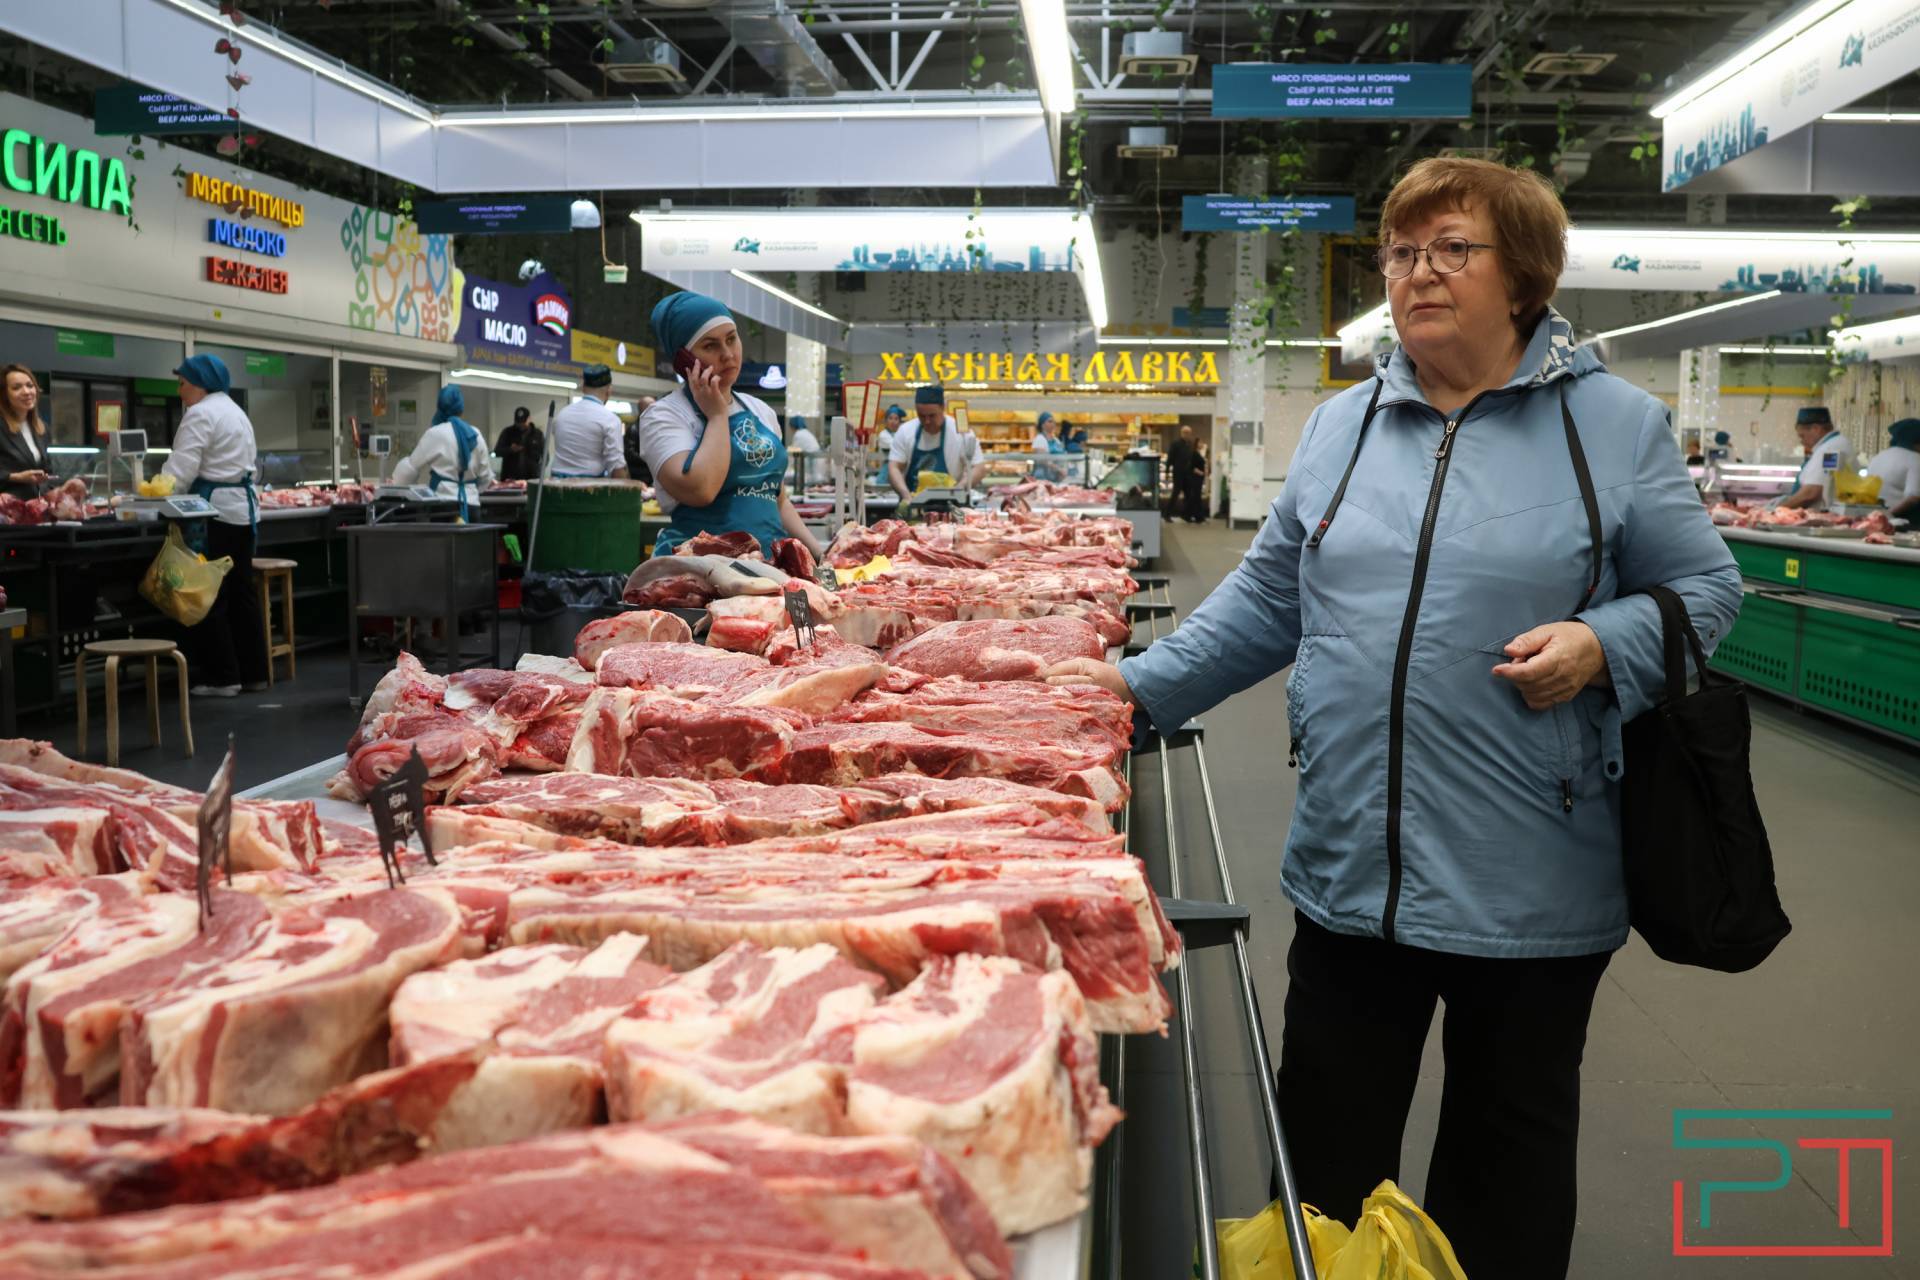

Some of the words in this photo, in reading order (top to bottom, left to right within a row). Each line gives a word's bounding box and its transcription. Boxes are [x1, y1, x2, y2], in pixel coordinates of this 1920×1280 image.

[1271, 74, 1301, 83] МЯСО
[1302, 74, 1356, 83] ГОВЯДИНЫ
[1357, 74, 1366, 83] И
[1367, 74, 1411, 83] КОНИНЫ
[1317, 86, 1336, 94] ИТЕ
[1361, 86, 1373, 94] АТ
[1375, 86, 1394, 94] ИТЕ
[1286, 97, 1311, 106] BEEF
[1311, 97, 1333, 106] AND
[1334, 97, 1367, 106] HORSE
[1368, 97, 1395, 106] MEAT
[158, 115, 179, 124] BEEF
[179, 114, 197, 123] AND
[198, 114, 220, 122] LAMB
[4, 127, 131, 216] СИЛА
[192, 171, 244, 205] МЯСО
[248, 188, 305, 228] ПТИЦЫ
[18, 210, 68, 245] СЕТЬ
[214, 218, 287, 257] МОЛОКО
[472, 286, 499, 313] СЫР
[484, 318, 527, 347] МАСЛО
[878, 351, 1072, 381] ХЛЕБНАЯ
[1083, 351, 1221, 383] ЛАВКА
